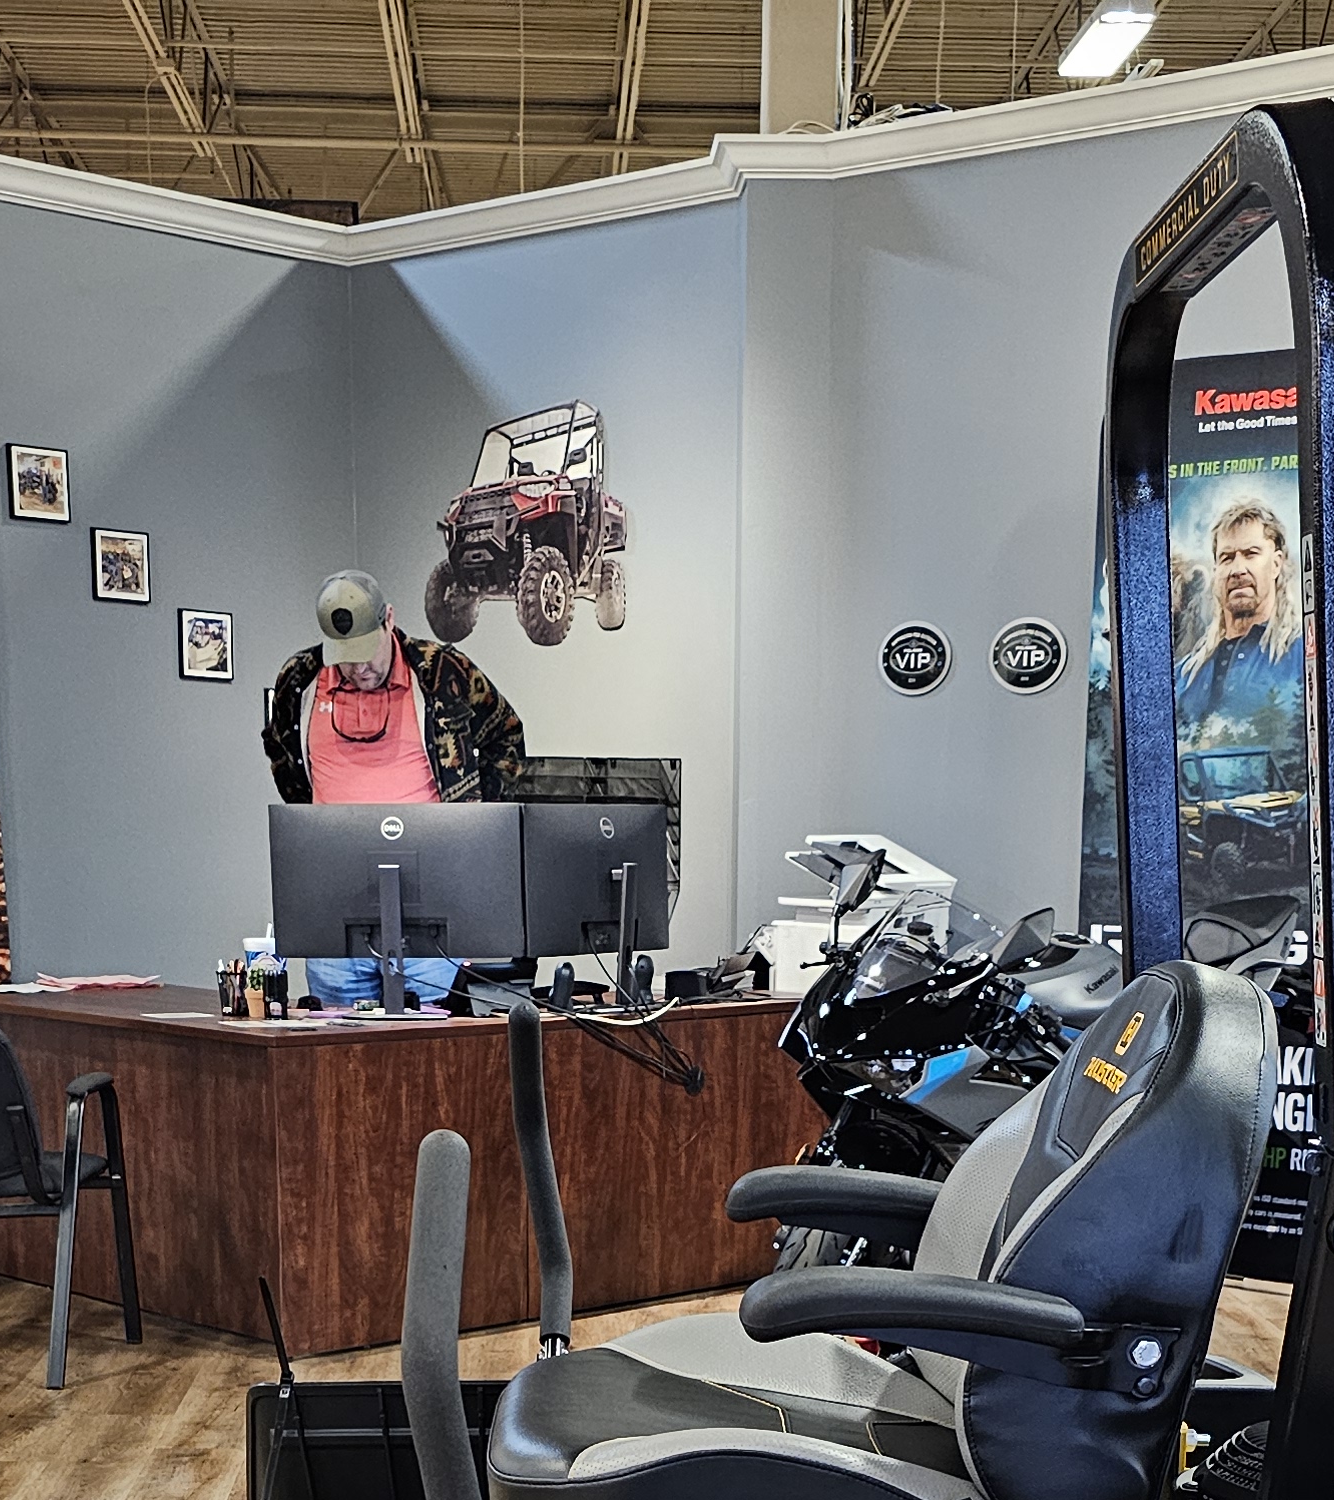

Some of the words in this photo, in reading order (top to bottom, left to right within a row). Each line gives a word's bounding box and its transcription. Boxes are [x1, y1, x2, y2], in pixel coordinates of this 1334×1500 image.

[1140, 189, 1200, 271] COMMERCIAL
[1202, 151, 1232, 206] DUTY
[1194, 386, 1297, 416] Kawasa
[1198, 421, 1216, 434] Let
[1217, 420, 1235, 432] the
[1236, 417, 1264, 430] Good
[1265, 415, 1297, 427] Times
[1179, 463, 1194, 478] IN
[1196, 460, 1221, 476] THE
[1223, 457, 1268, 474] FRONT.
[1271, 454, 1298, 471] PAR
[895, 652, 931, 669] VIP
[1007, 650, 1045, 667] VIP
[1084, 964, 1120, 995] Kawasaki
[1083, 1056, 1128, 1095] HUSTLER
